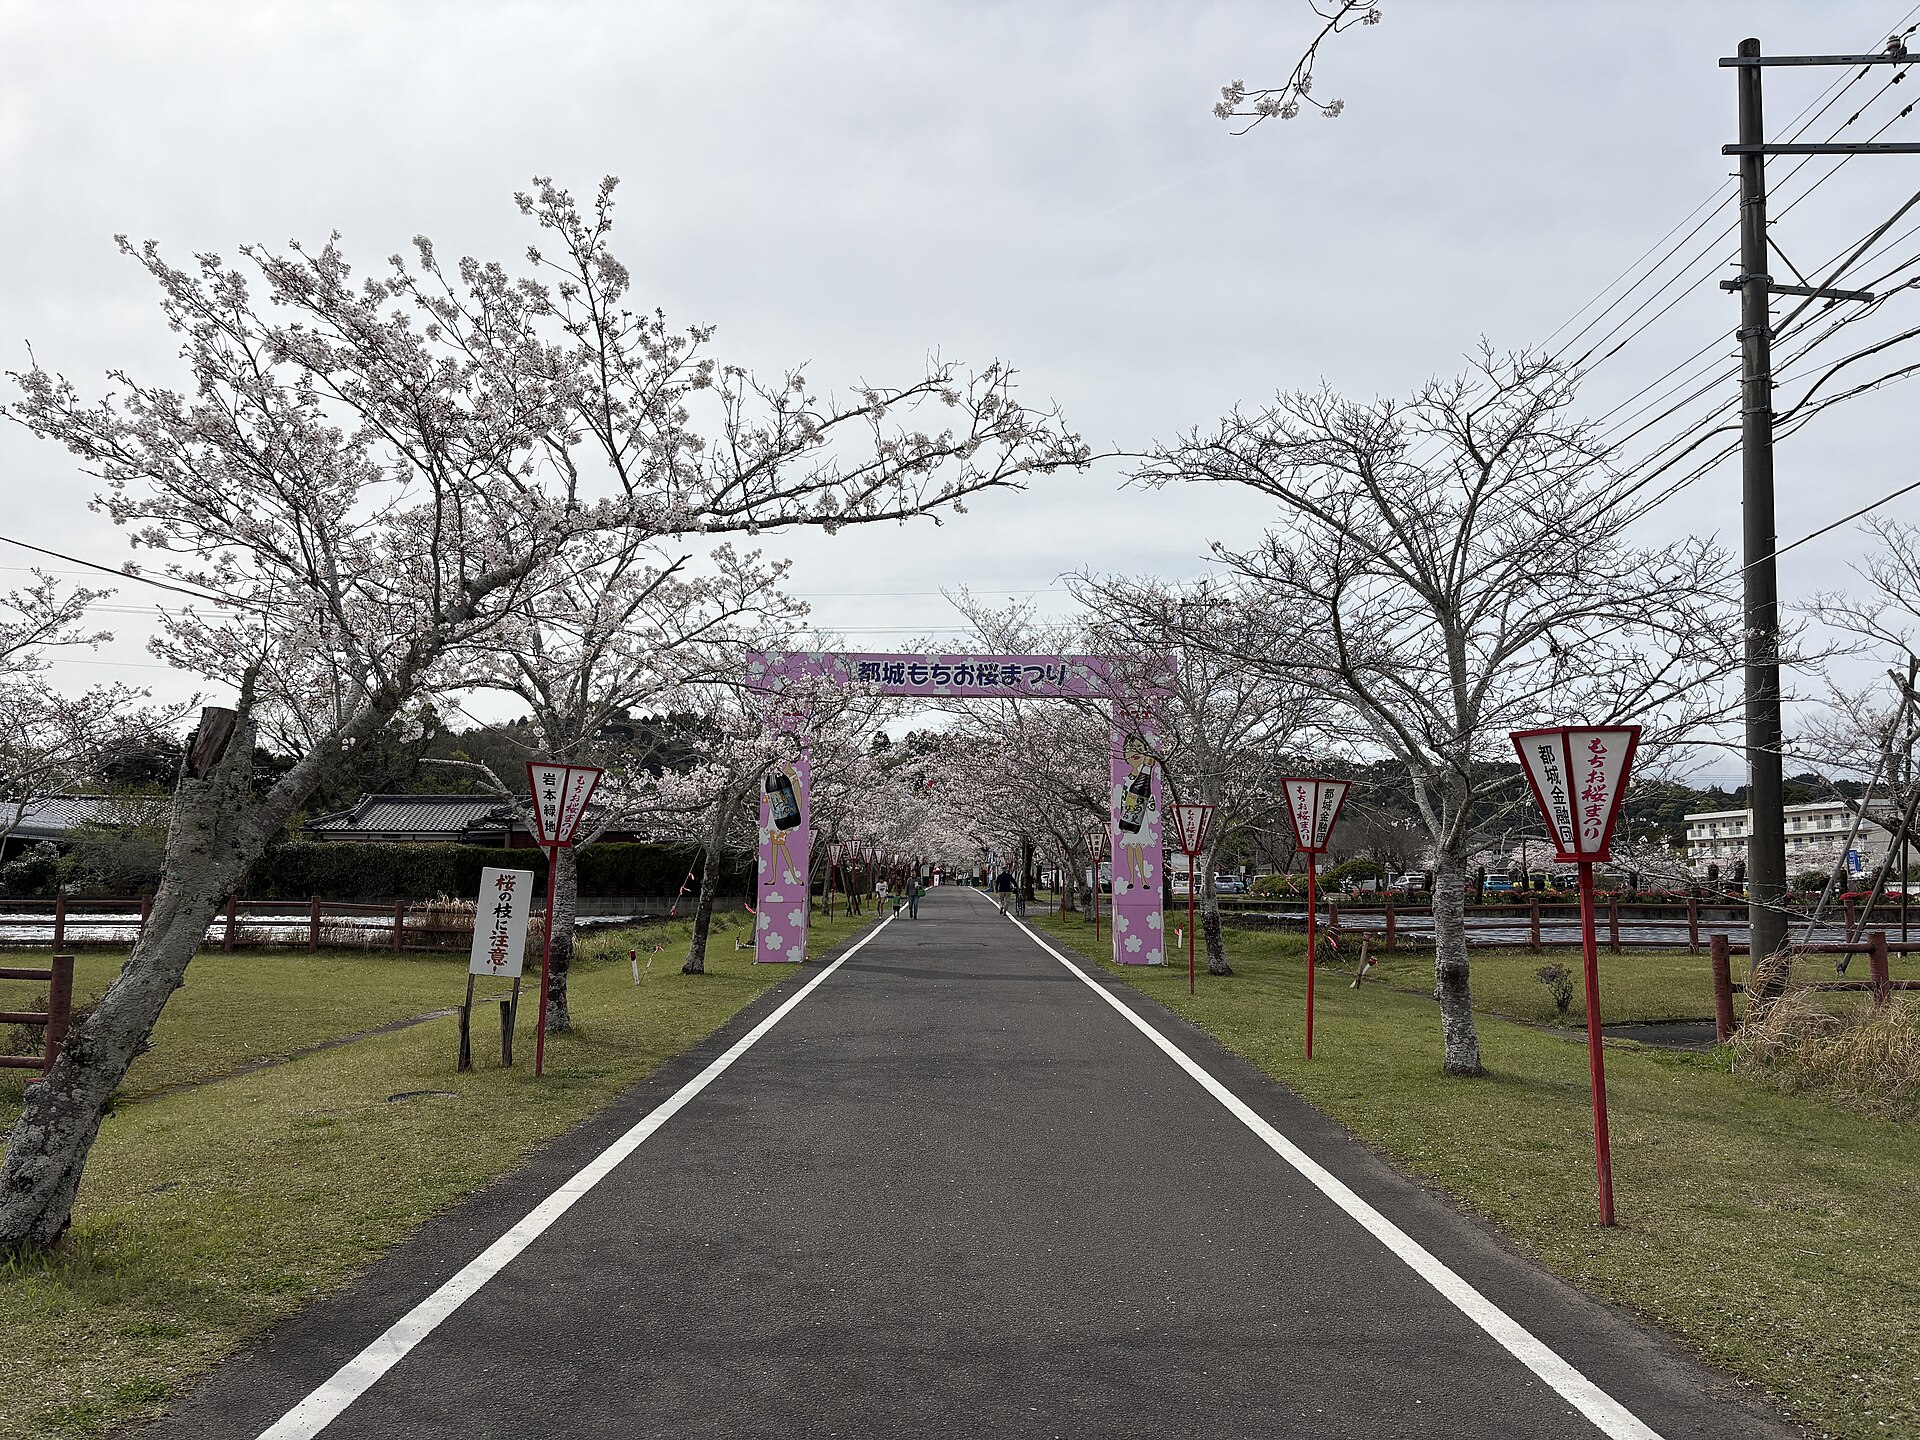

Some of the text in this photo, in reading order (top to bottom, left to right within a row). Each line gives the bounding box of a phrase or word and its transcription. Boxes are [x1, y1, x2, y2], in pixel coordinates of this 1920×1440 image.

[857, 661, 1067, 686] 都城もちお桜まつり
[542, 772, 557, 833] 岩本緑地
[560, 774, 586, 836] もちお桜まつり
[1296, 784, 1311, 842] もちお桜まつり
[1315, 788, 1336, 843] 都城金融団
[1537, 744, 1574, 844] 都城金融団
[1581, 737, 1610, 840] もちお桜まつり
